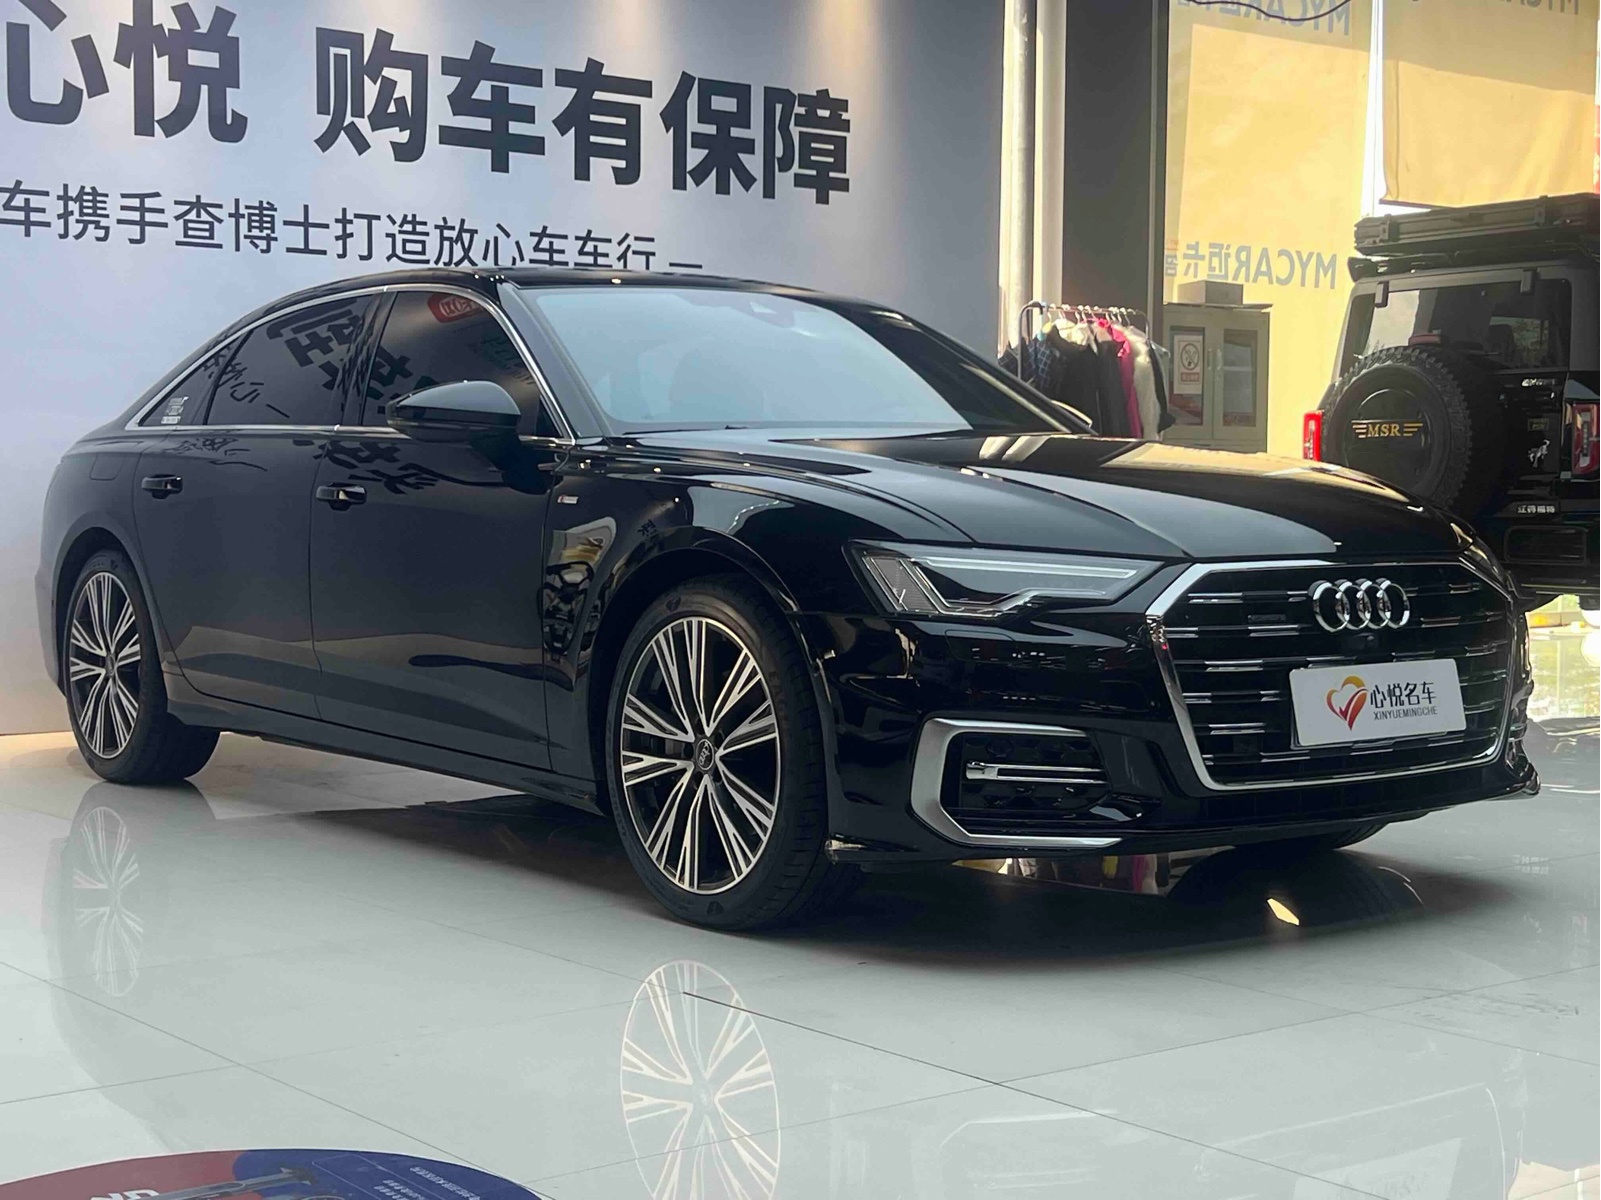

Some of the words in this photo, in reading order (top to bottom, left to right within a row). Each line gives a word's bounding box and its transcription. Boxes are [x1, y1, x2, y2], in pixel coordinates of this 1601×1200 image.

[6, 0, 248, 143] 心悦
[314, 28, 851, 205] 购车有保障
[0, 180, 656, 270] 车携手查博士打造放心车车行
[1367, 423, 1400, 437] MSR
[1370, 681, 1437, 708] 心悦名车
[1373, 706, 1438, 721] XINYUEMINGCHE
